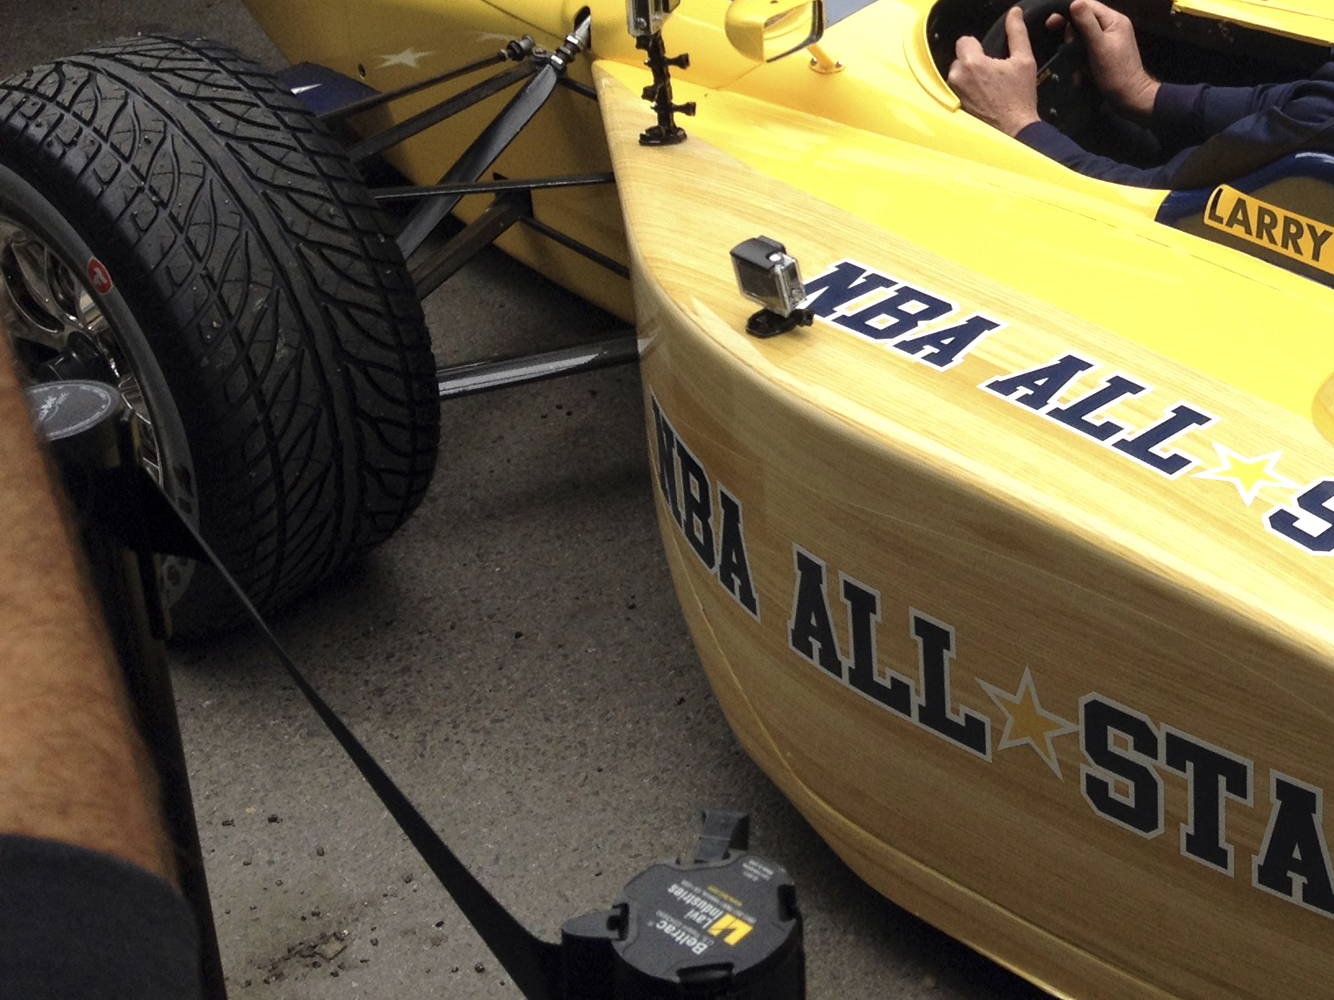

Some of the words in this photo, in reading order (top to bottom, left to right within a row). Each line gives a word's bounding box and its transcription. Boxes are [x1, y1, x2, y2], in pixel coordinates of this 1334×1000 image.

[1207, 188, 1333, 262] LARRY
[800, 260, 1002, 370] NBA
[983, 353, 1215, 477] ALL
[652, 395, 760, 622] NBA
[789, 545, 989, 759] ALL
[668, 883, 724, 919] Industries
[683, 909, 714, 930] Lavi
